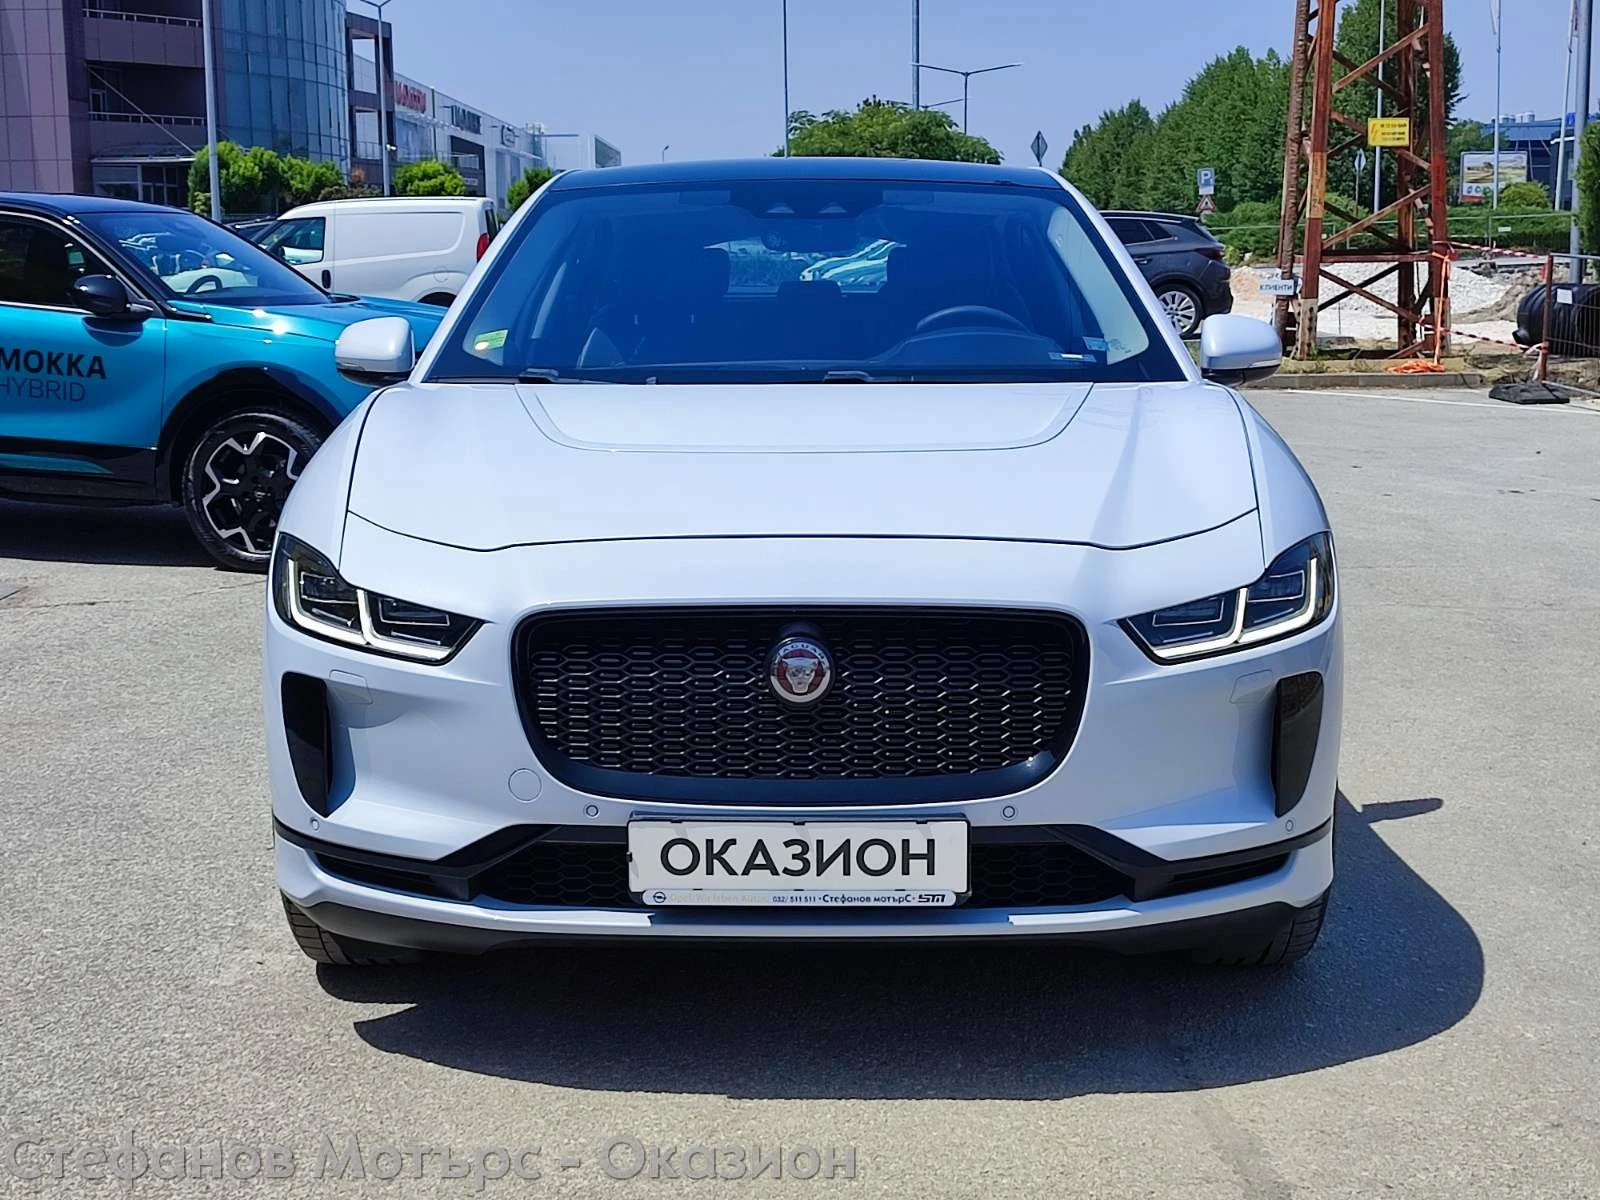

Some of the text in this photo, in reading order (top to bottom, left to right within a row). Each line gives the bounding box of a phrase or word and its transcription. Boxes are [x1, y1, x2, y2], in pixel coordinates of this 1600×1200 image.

[1201, 170, 1211, 184] P
[0, 347, 107, 379] MOKKA
[0, 375, 86, 402] HYBRID
[660, 838, 935, 876] ОКАЗИОН
